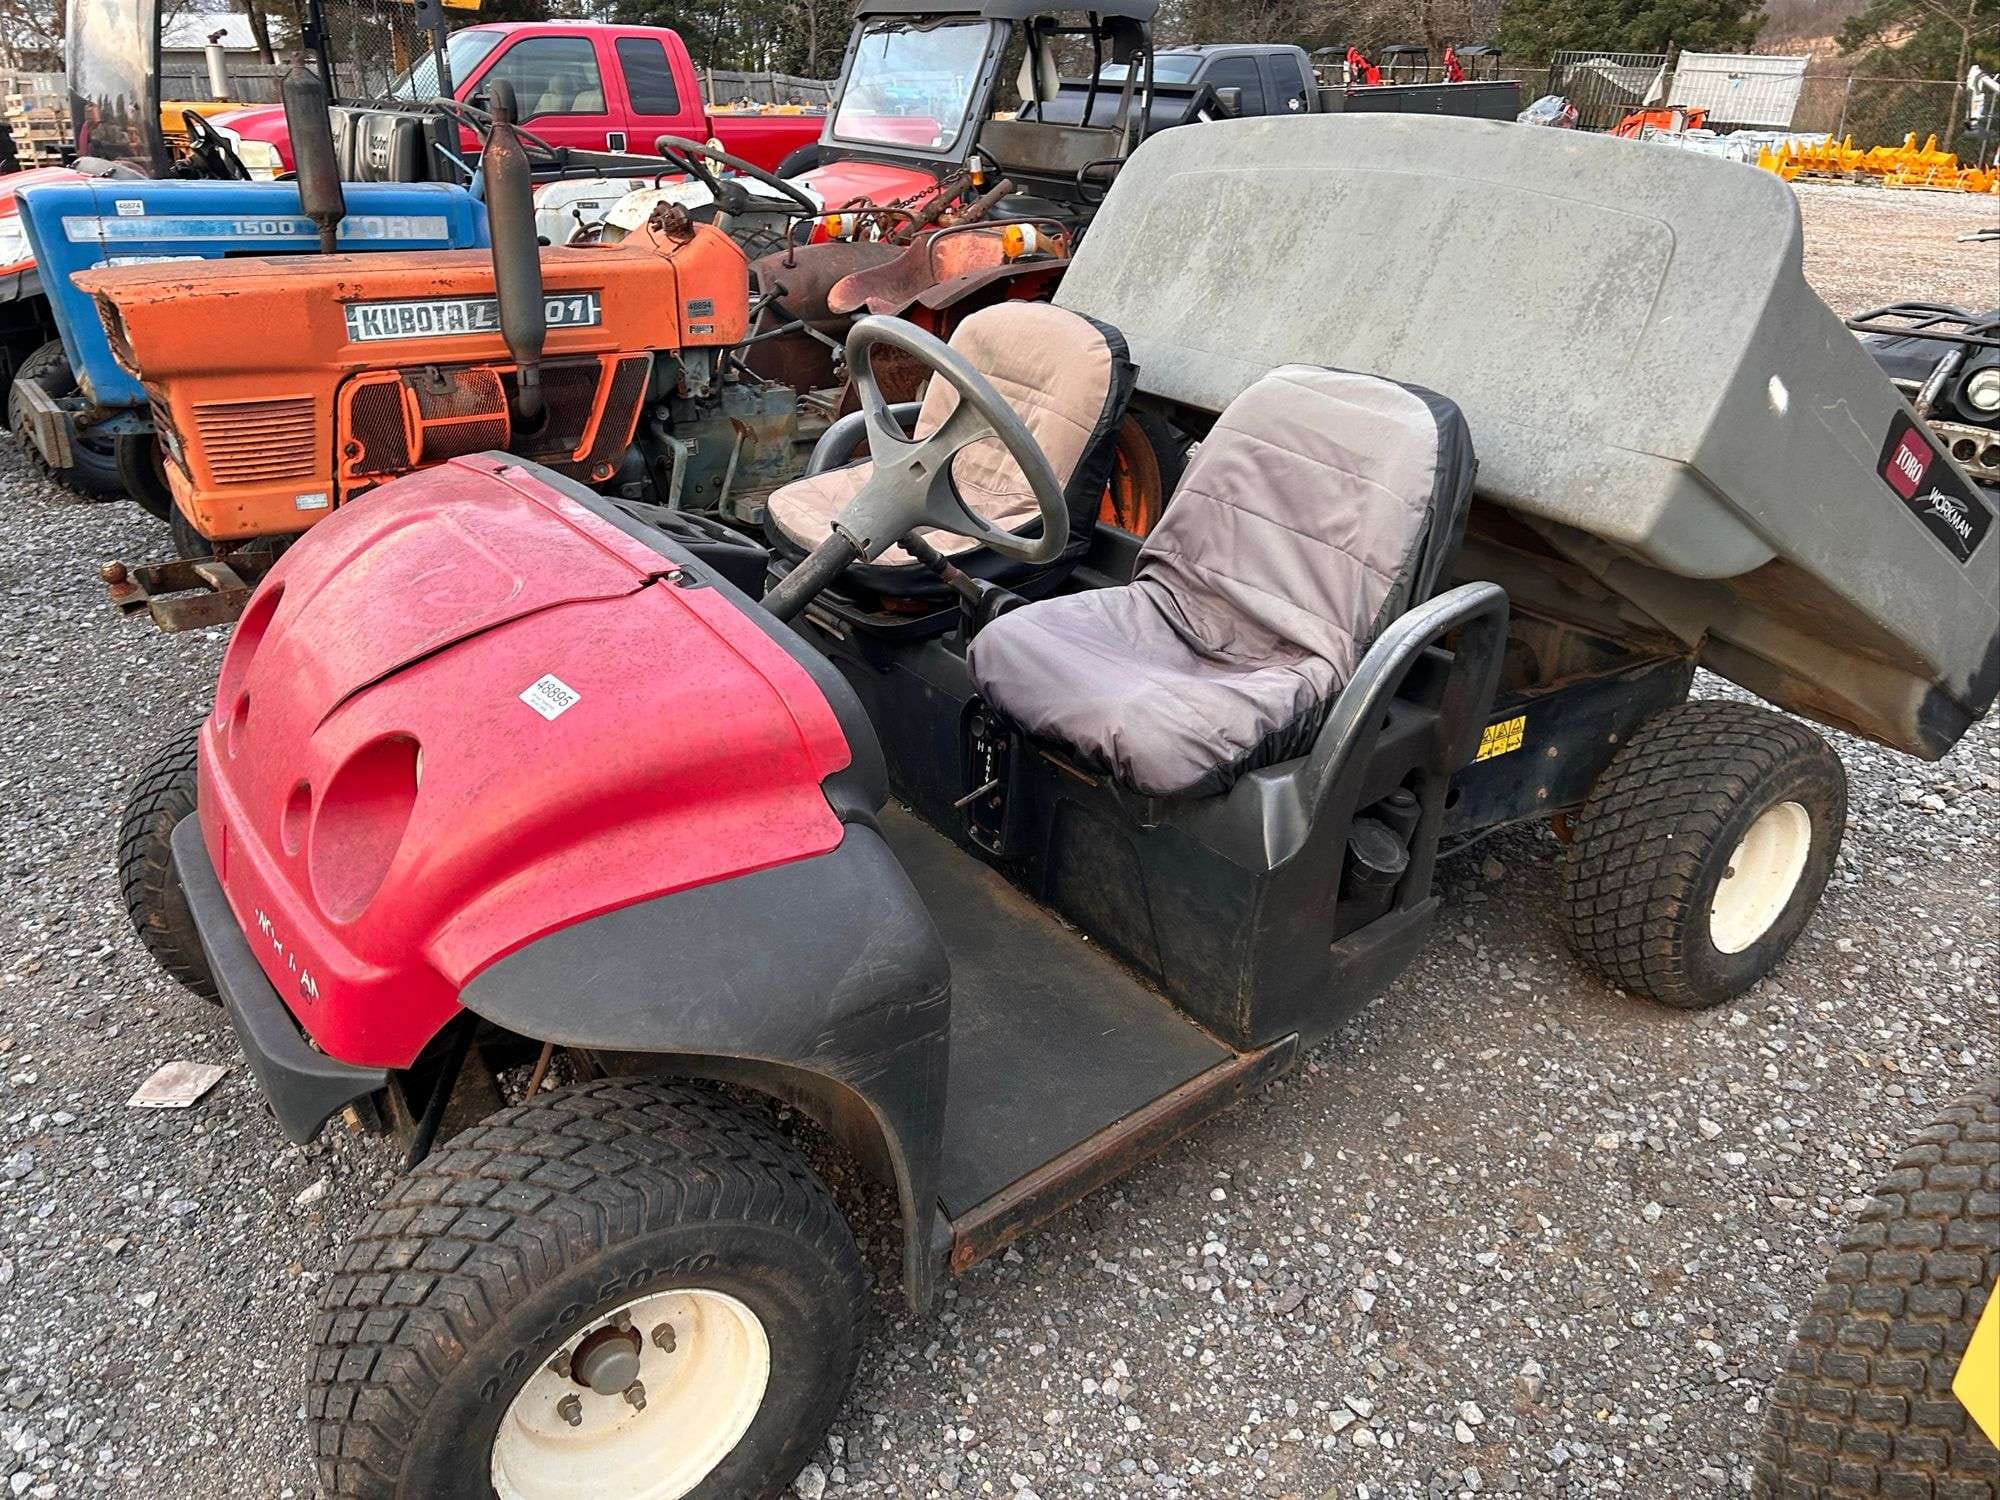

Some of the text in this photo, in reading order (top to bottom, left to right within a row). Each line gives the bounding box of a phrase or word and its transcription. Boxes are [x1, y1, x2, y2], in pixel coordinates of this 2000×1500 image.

[232, 221, 295, 235] 1500
[361, 304, 467, 336] KUBOTA
[1895, 444, 1923, 483] TORO
[1928, 486, 1974, 539] WORKMAN
[537, 680, 574, 707] 48895
